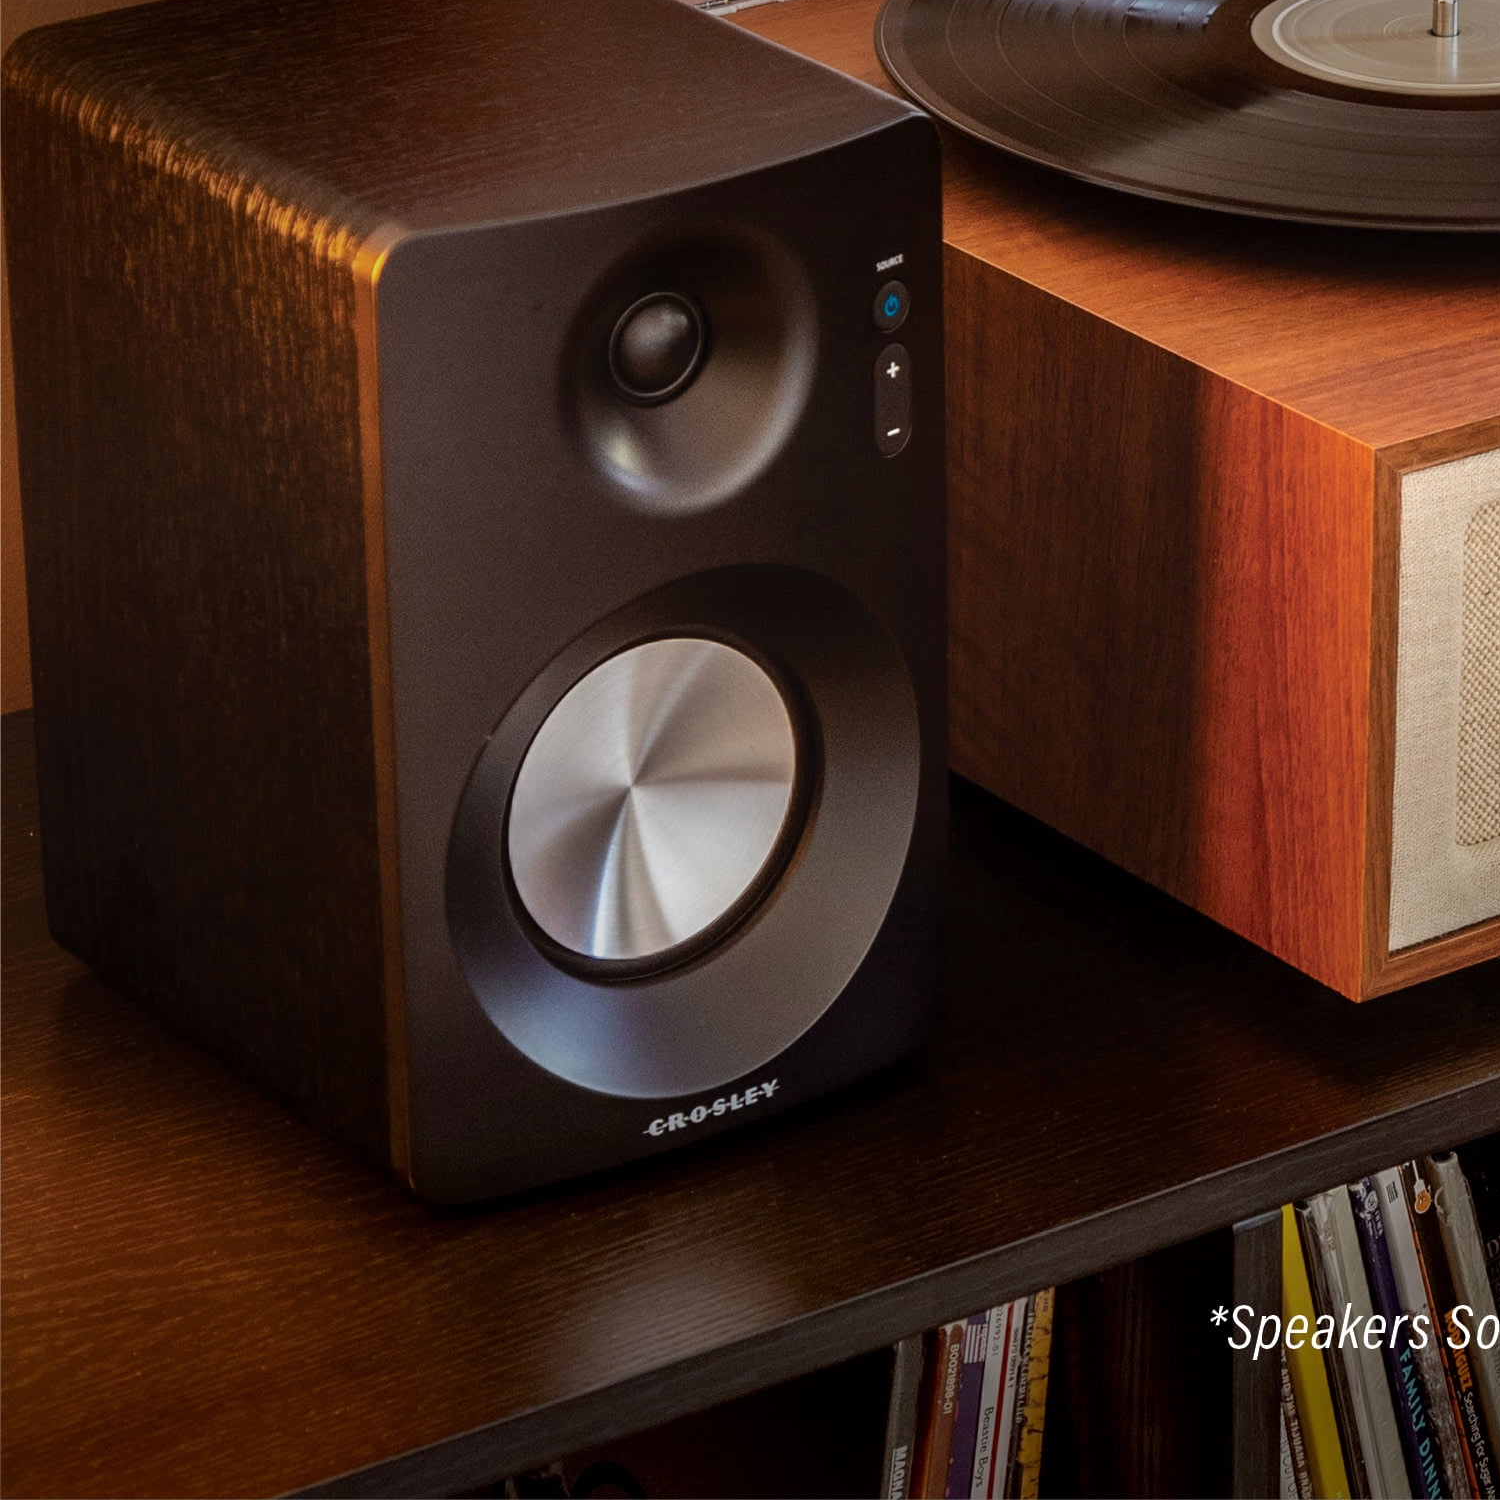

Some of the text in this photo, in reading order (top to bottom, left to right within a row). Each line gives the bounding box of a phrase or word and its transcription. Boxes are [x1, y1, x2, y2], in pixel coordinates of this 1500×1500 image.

[642, 1078, 780, 1136] CROSLEY
[1396, 1348, 1428, 1431] FAMILY
[972, 1405, 994, 1488] Beastie Boys
[1460, 1391, 1483, 1442] Searching
[1476, 1458, 1494, 1486] Sugar
